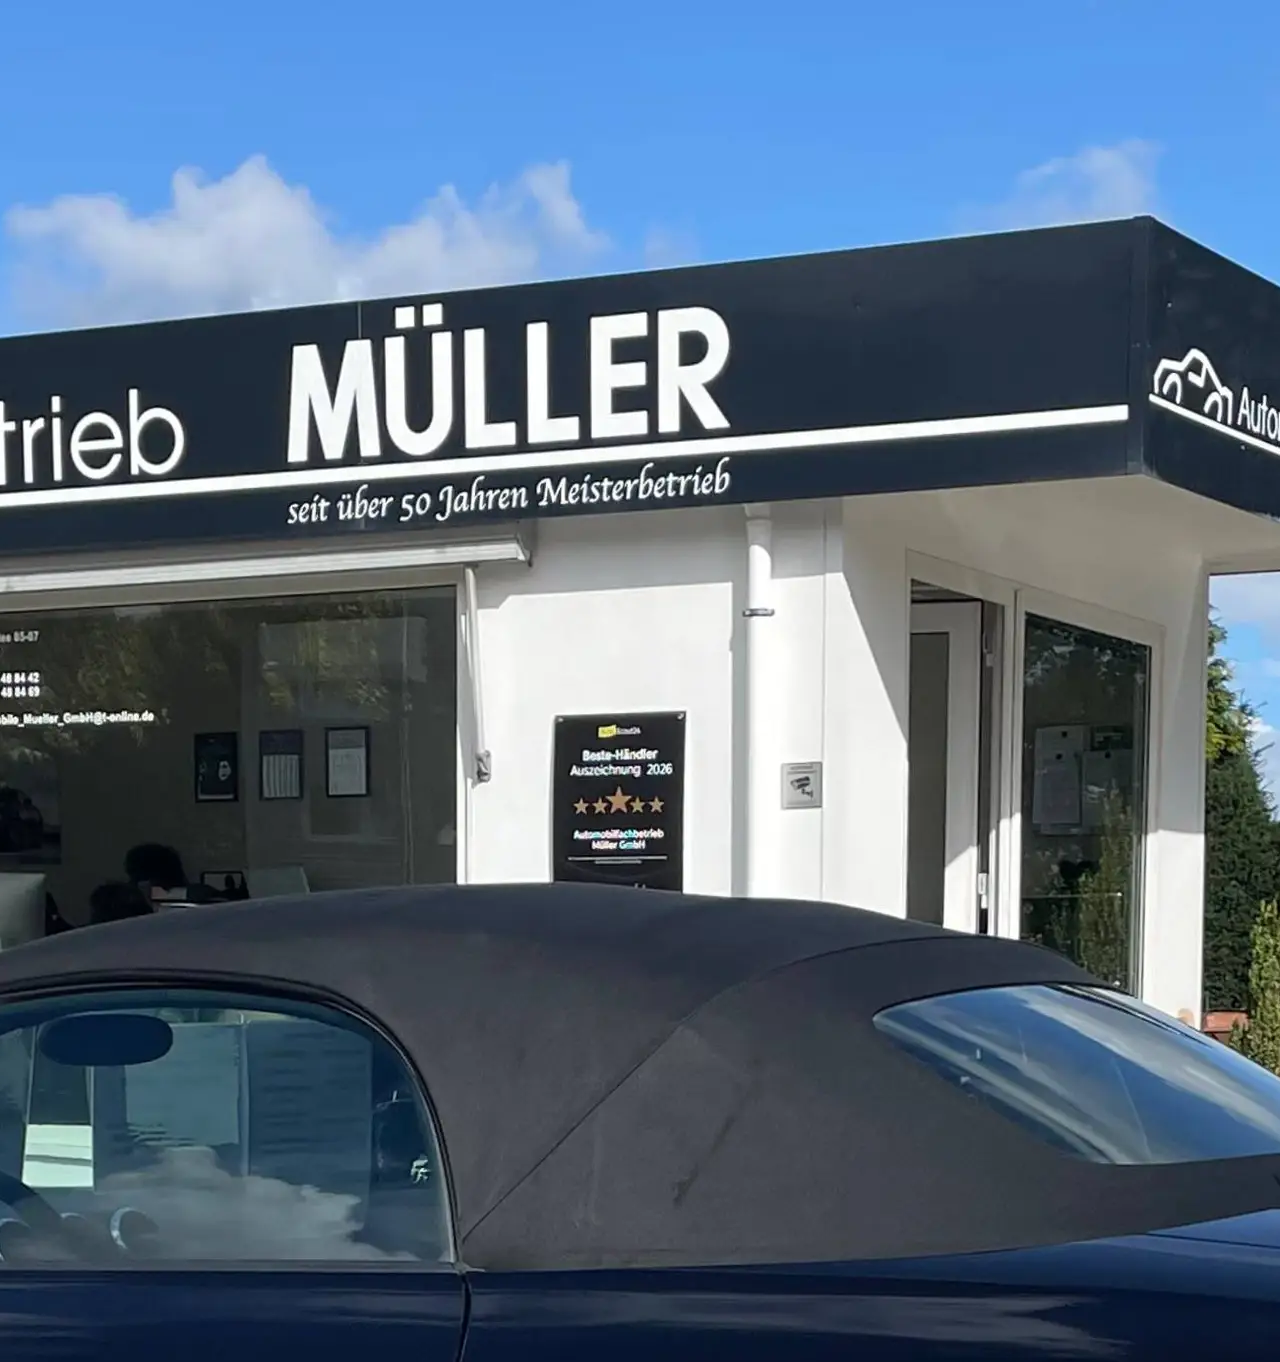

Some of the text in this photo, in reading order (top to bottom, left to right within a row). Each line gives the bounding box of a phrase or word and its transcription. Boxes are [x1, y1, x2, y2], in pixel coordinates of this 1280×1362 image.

[287, 303, 731, 464] MÜLLER
[287, 457, 732, 525] seit über 50 Jahren Meisterbetrieb
[27, 672, 40, 683] 42
[582, 748, 658, 761] Beste-Händler
[570, 763, 673, 777] Auszeichnung 2026
[619, 840, 646, 849] GmbH
